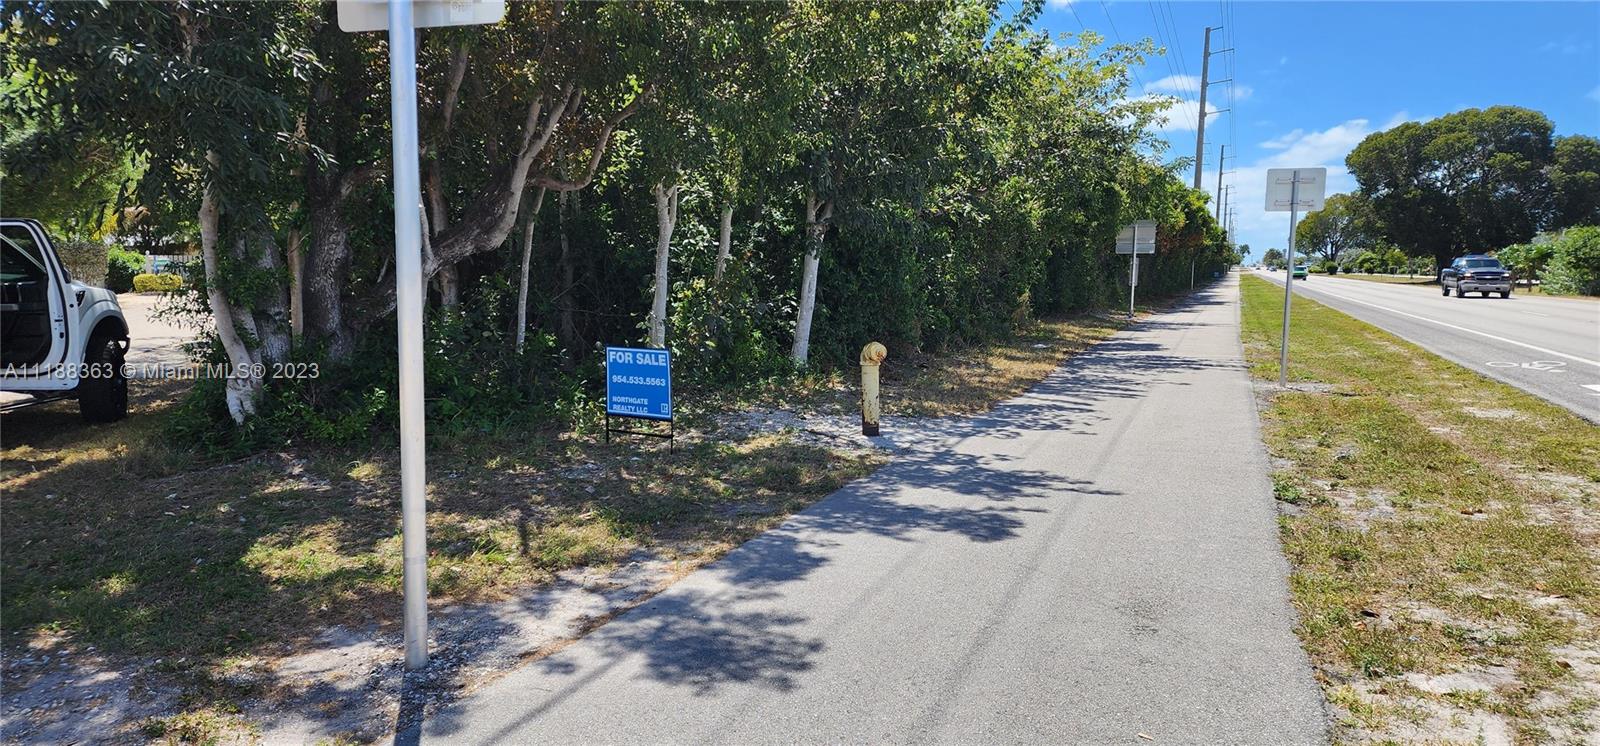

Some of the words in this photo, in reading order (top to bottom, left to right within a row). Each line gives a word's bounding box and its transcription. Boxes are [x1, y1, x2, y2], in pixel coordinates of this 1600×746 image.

[609, 351, 633, 364] FOR
[636, 353, 667, 366] SALE
[612, 375, 666, 387] 954.533.5563
[612, 396, 649, 405] NORTHGATE
[612, 404, 635, 412] REALTY
